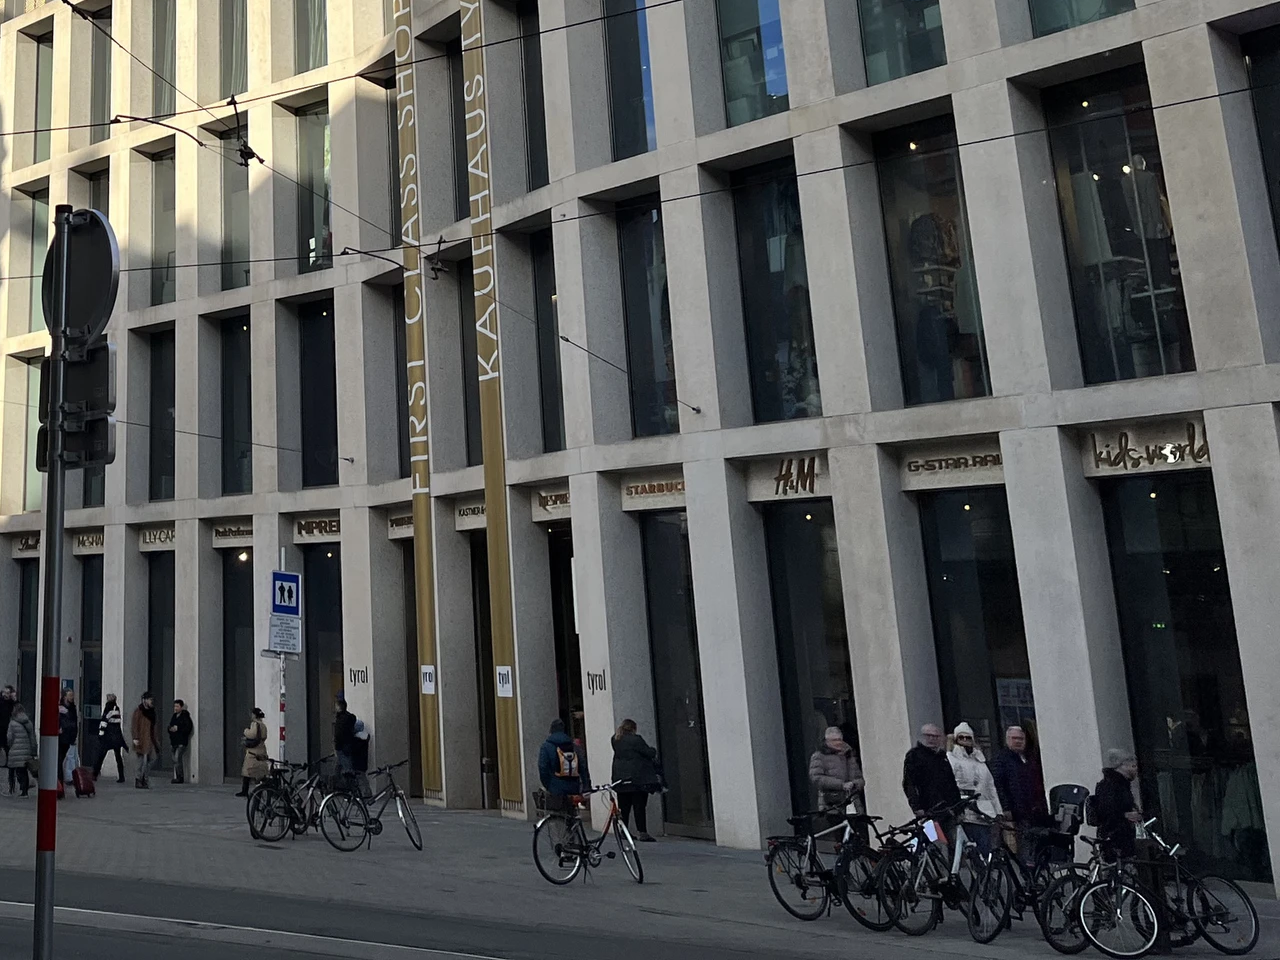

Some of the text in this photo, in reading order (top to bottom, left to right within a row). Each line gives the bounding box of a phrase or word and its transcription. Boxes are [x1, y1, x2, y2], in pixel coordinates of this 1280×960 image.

[400, 153, 421, 324] CLASS
[464, 74, 499, 382] KAUFHAUS
[774, 456, 815, 496] H&M
[349, 665, 369, 687] tyrol
[586, 668, 607, 696] tyrol
